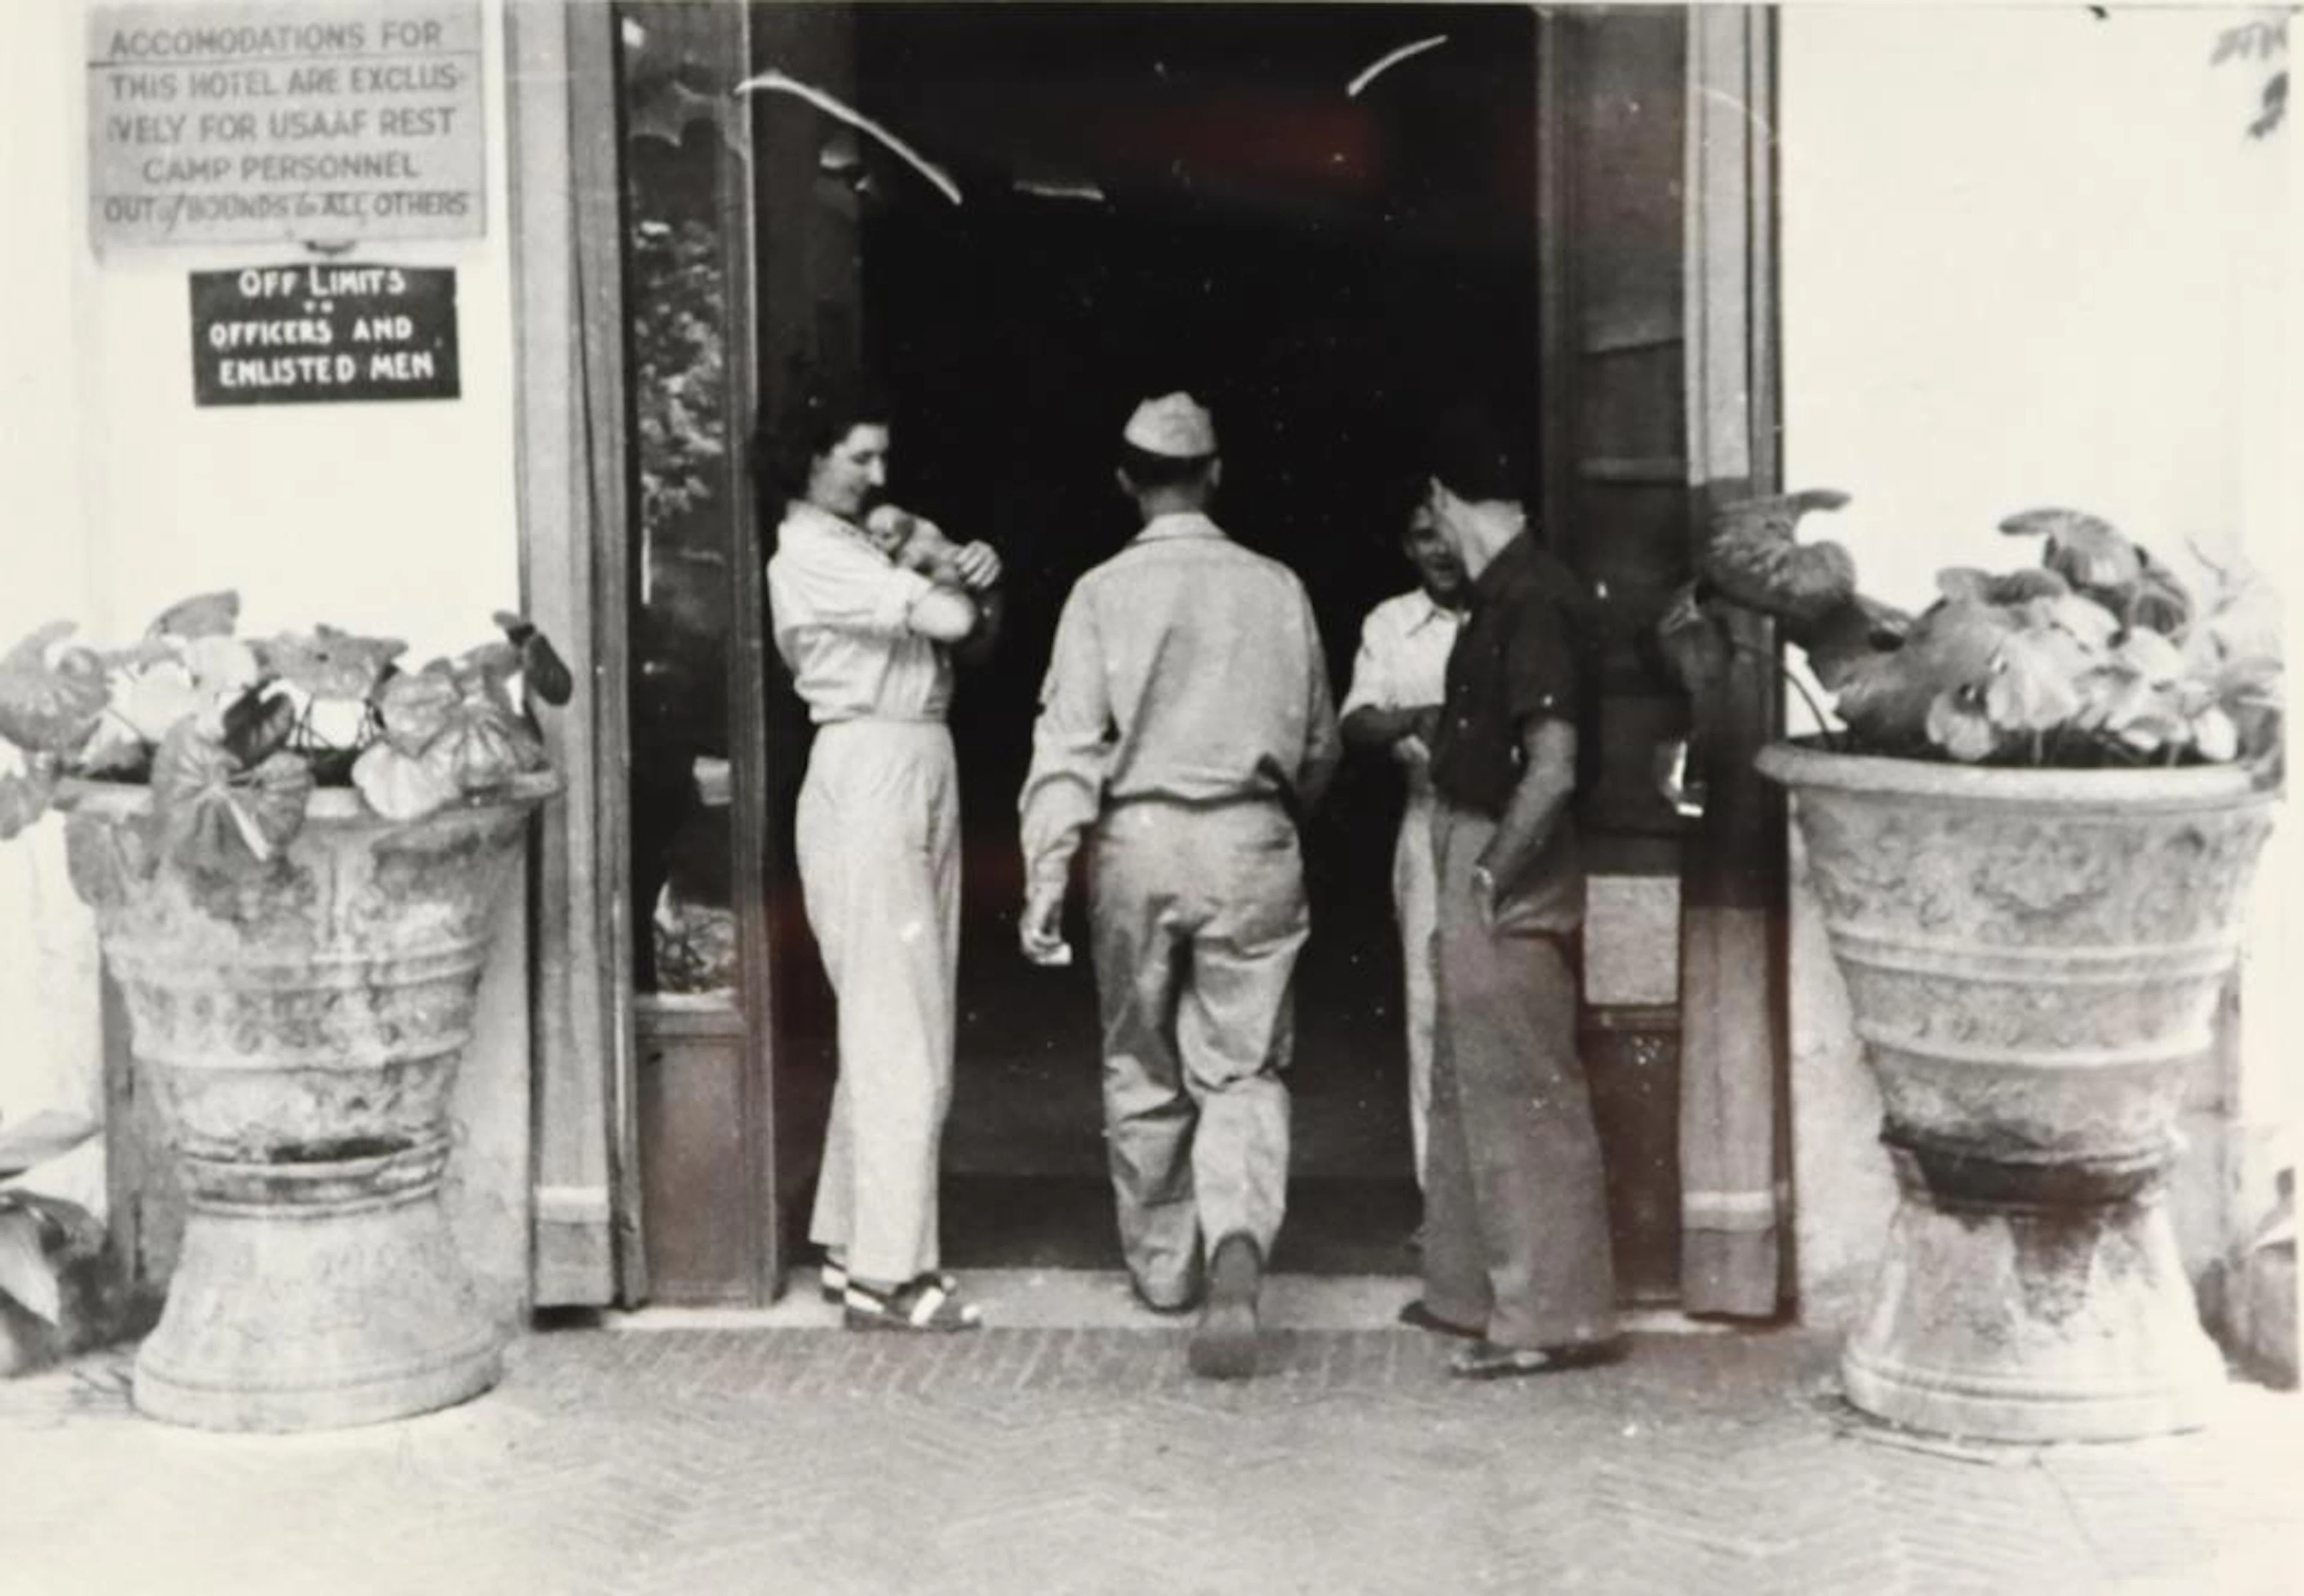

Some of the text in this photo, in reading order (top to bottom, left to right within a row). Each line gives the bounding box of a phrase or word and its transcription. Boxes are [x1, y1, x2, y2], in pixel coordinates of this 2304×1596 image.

[108, 20, 443, 55] ACCOMODATIONS FOR
[107, 71, 178, 101] THIS
[188, 68, 280, 98] HOTEL
[288, 66, 335, 94] ARE
[200, 112, 257, 142] FOR
[269, 108, 367, 140] USAAF
[379, 107, 455, 137] REST
[142, 150, 420, 184] CAMP PERSONNEL
[104, 196, 156, 223] OUT
[187, 193, 289, 222] BOUNDS
[322, 191, 363, 217] ALL
[373, 191, 469, 217] OTHERS
[239, 264, 406, 297] OFF LIMITS
[210, 316, 413, 346] OFFICERS AND
[220, 351, 434, 386] ENLISTED MEN
